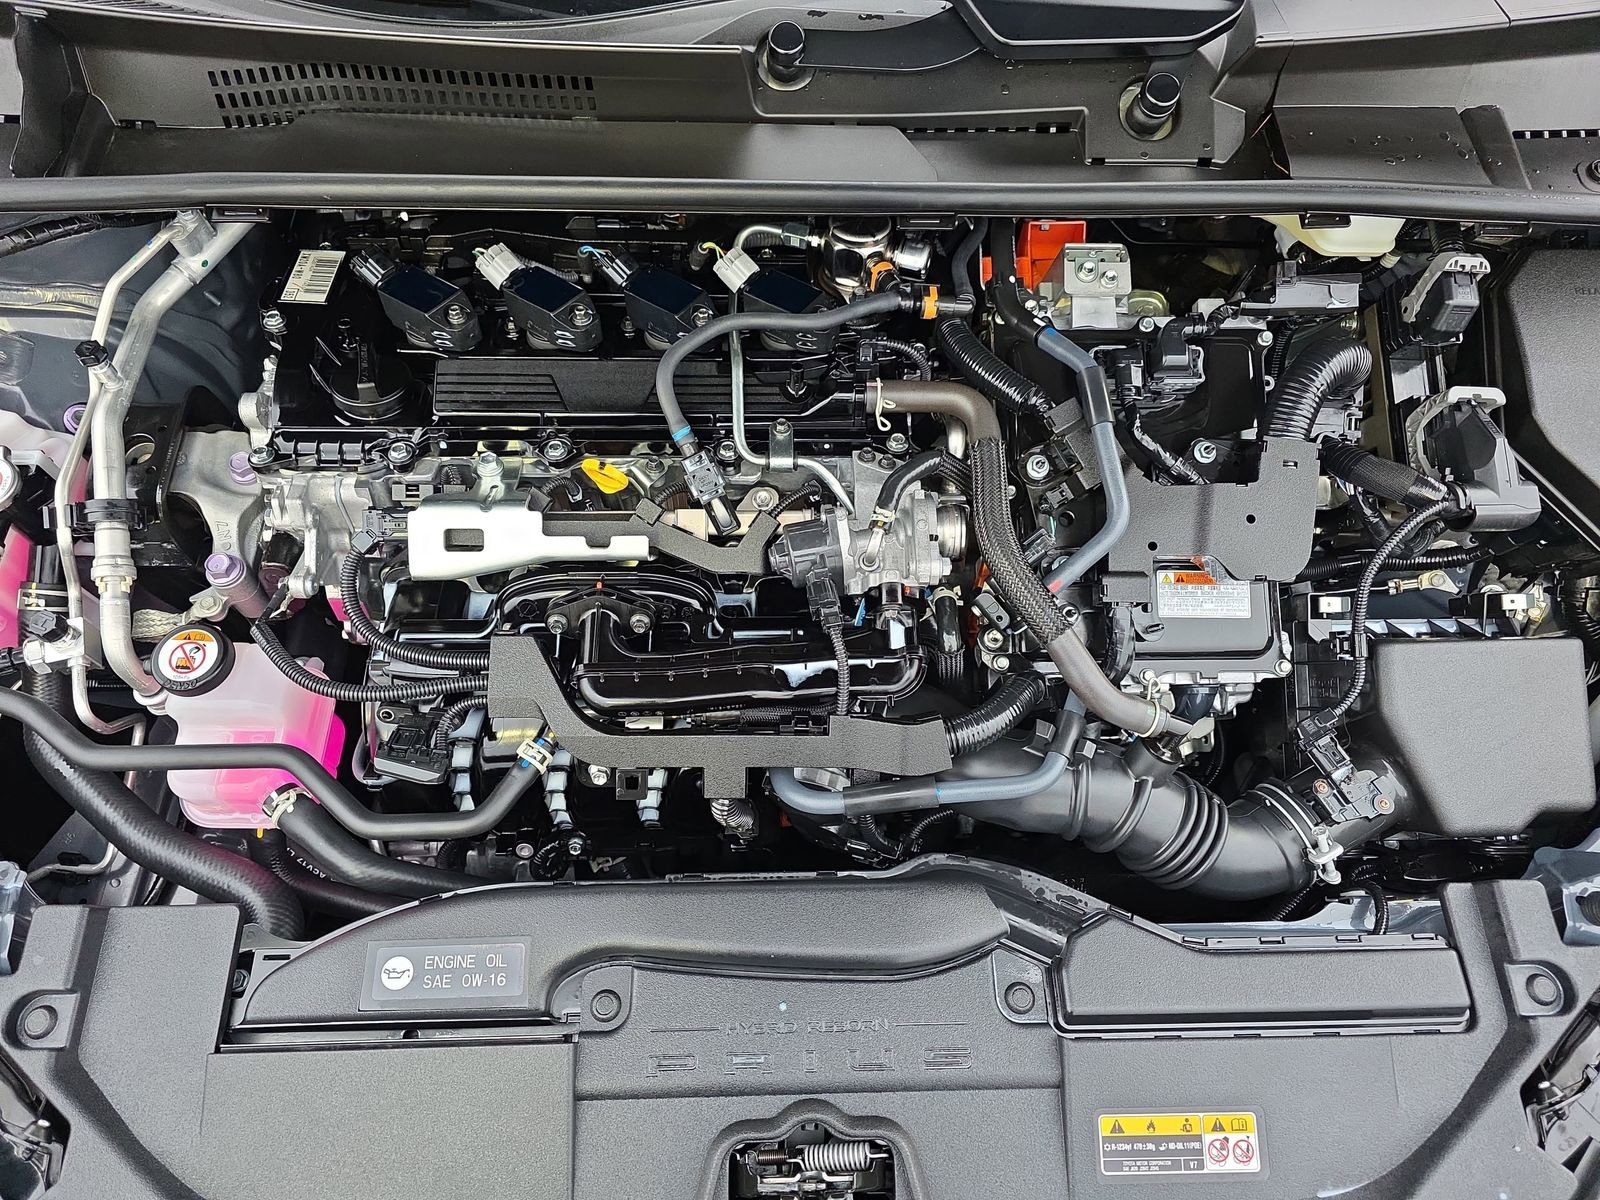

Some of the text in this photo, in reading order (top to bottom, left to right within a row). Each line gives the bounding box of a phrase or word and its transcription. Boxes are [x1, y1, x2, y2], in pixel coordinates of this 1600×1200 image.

[163, 679, 198, 690] DENSO
[296, 857, 327, 879] ACV17
[424, 953, 508, 970] ENGINE OIL
[422, 973, 507, 989] SAE 0W-16
[725, 1017, 889, 1036] HYBRID REBORN
[646, 1047, 972, 1078] PRIUS
